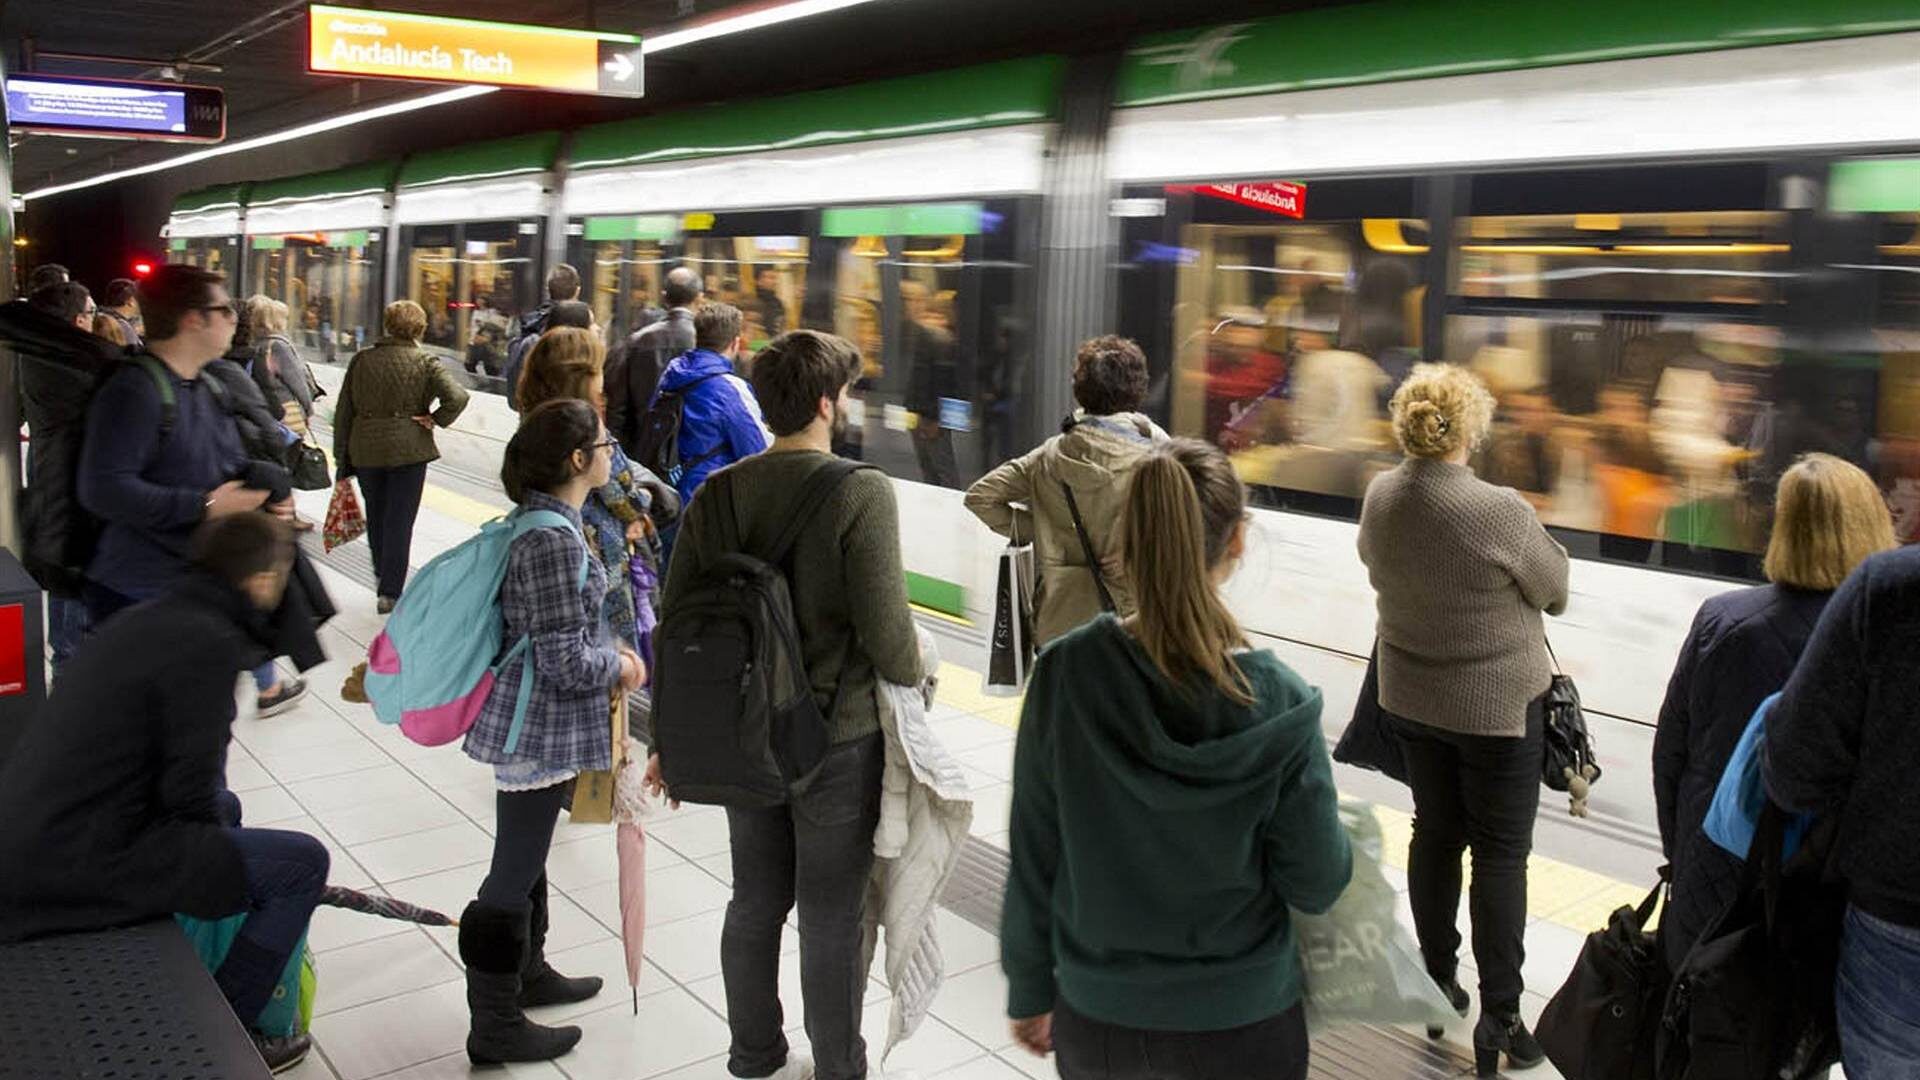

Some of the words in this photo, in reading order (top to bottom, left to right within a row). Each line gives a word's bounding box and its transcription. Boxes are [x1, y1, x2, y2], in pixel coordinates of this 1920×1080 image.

[331, 38, 453, 71] Andalucía
[459, 47, 513, 75] Tech
[1305, 921, 1387, 970] EAR
